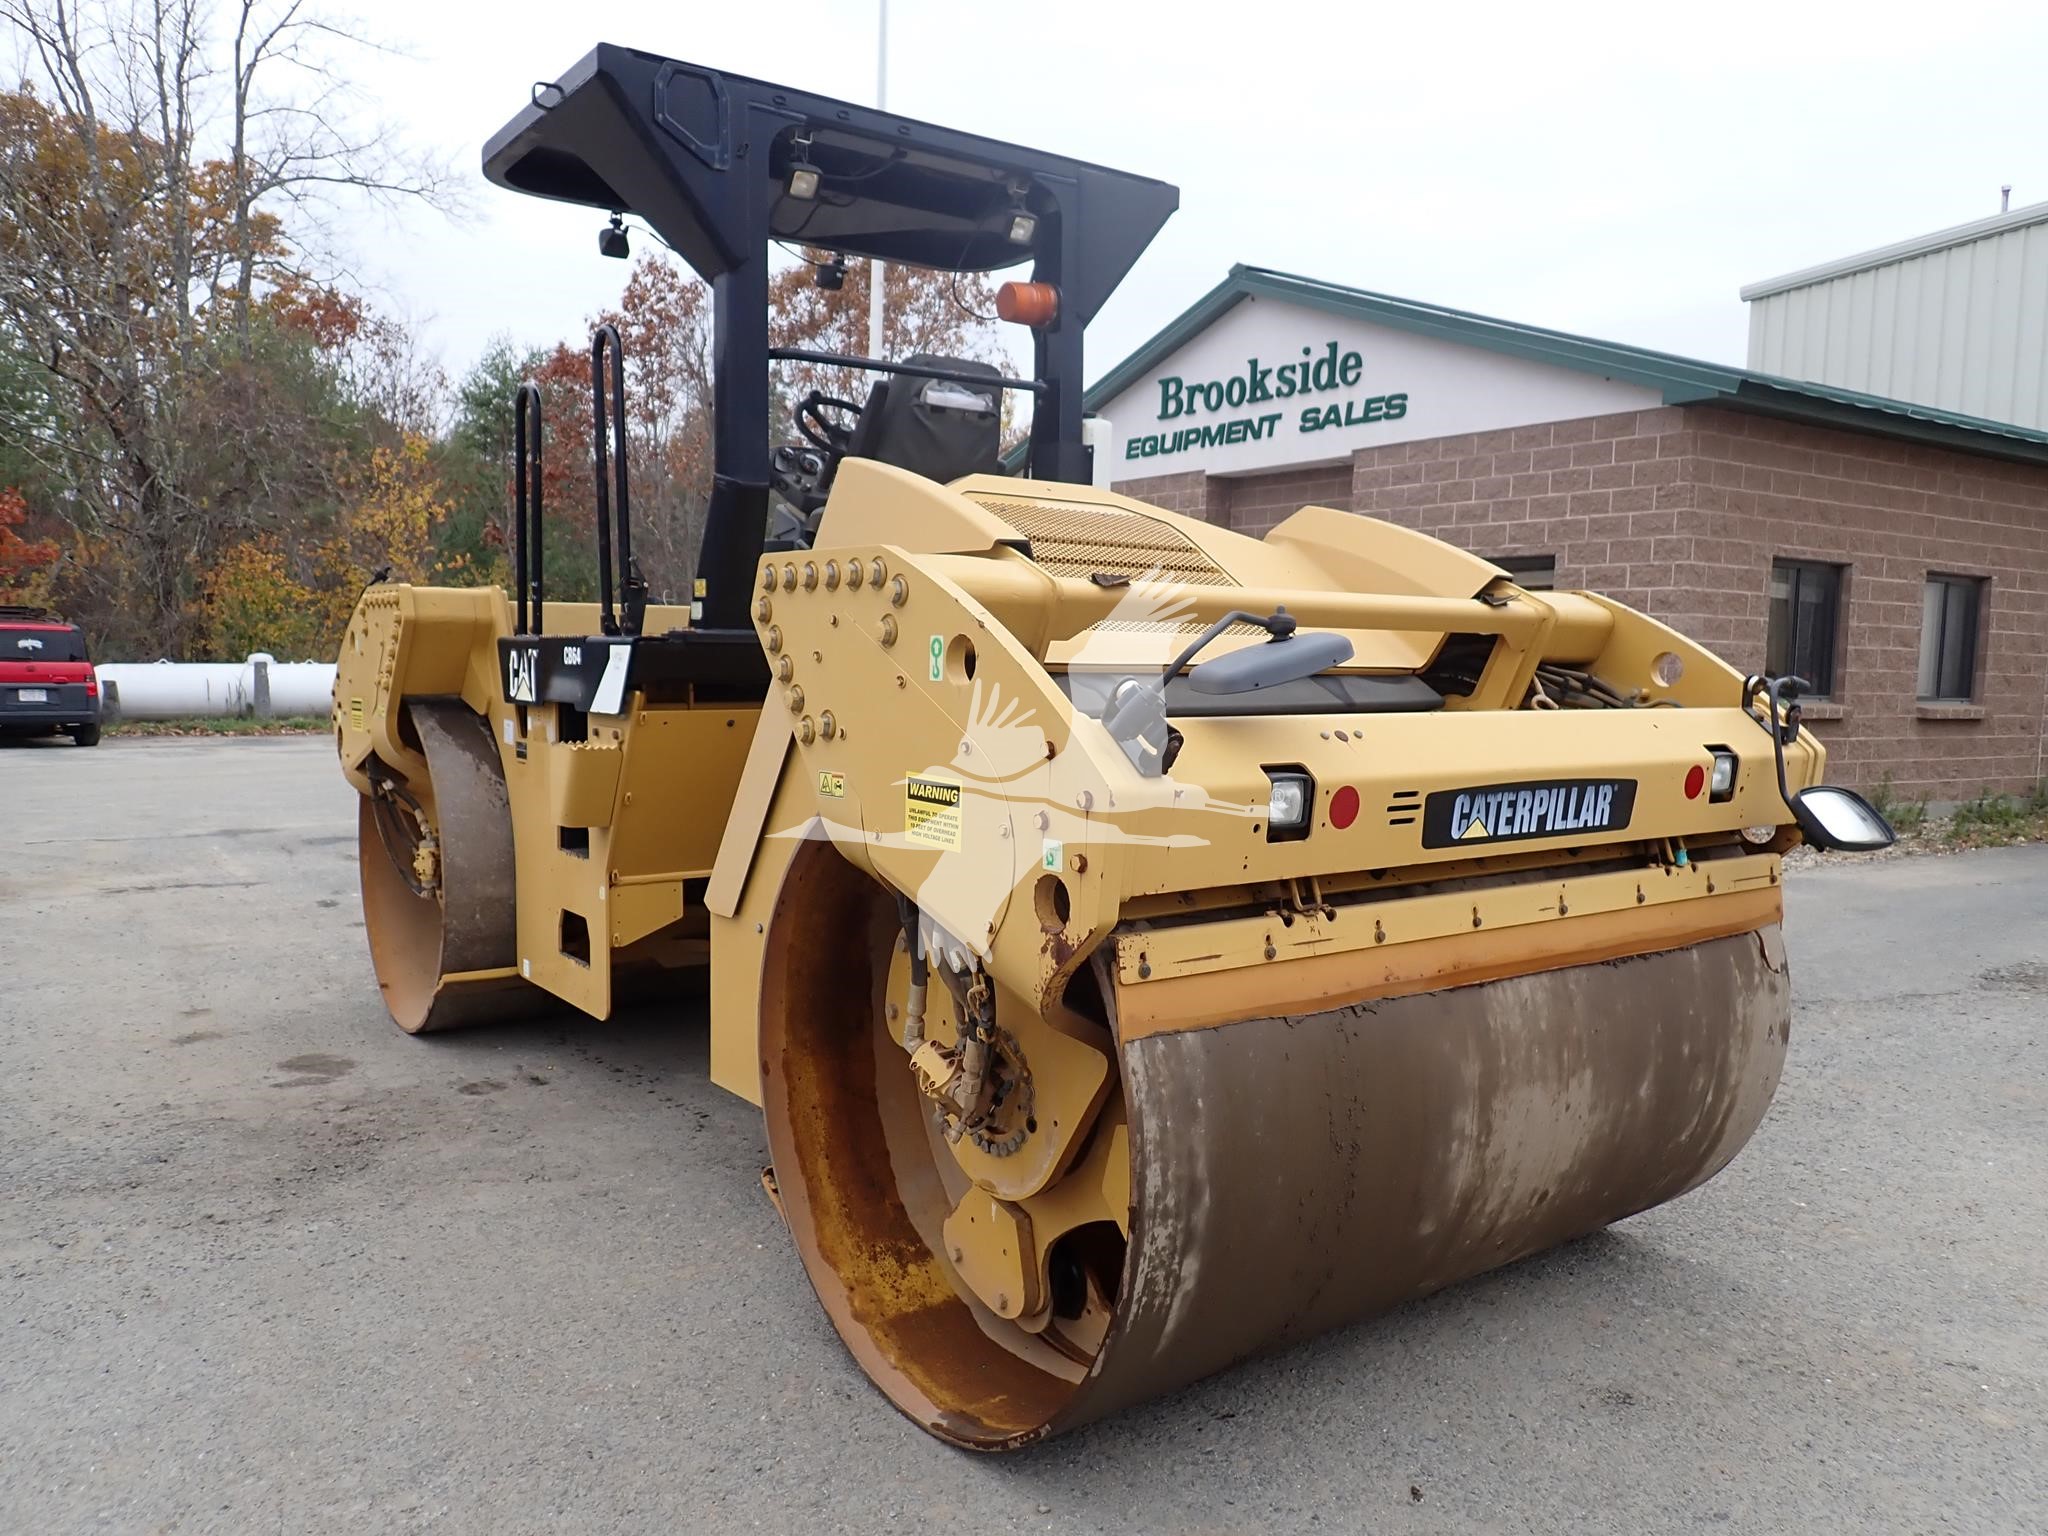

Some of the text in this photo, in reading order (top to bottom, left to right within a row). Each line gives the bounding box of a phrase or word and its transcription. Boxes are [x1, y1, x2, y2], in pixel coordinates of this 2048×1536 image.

[1157, 341, 1363, 420] Brookside
[1126, 393, 1408, 460] EQUIPMENT SALES
[563, 646, 581, 665] CB64
[509, 648, 538, 702] CAT
[910, 782, 958, 802] WARNING
[939, 813, 958, 822] OPERATE
[1451, 784, 1614, 840] CATERPILLAR
[918, 817, 942, 826] EQUIPMENT
[943, 822, 959, 830] WITHIN
[933, 828, 956, 836] OVERHEAD
[923, 832, 940, 841] VOLTAGE
